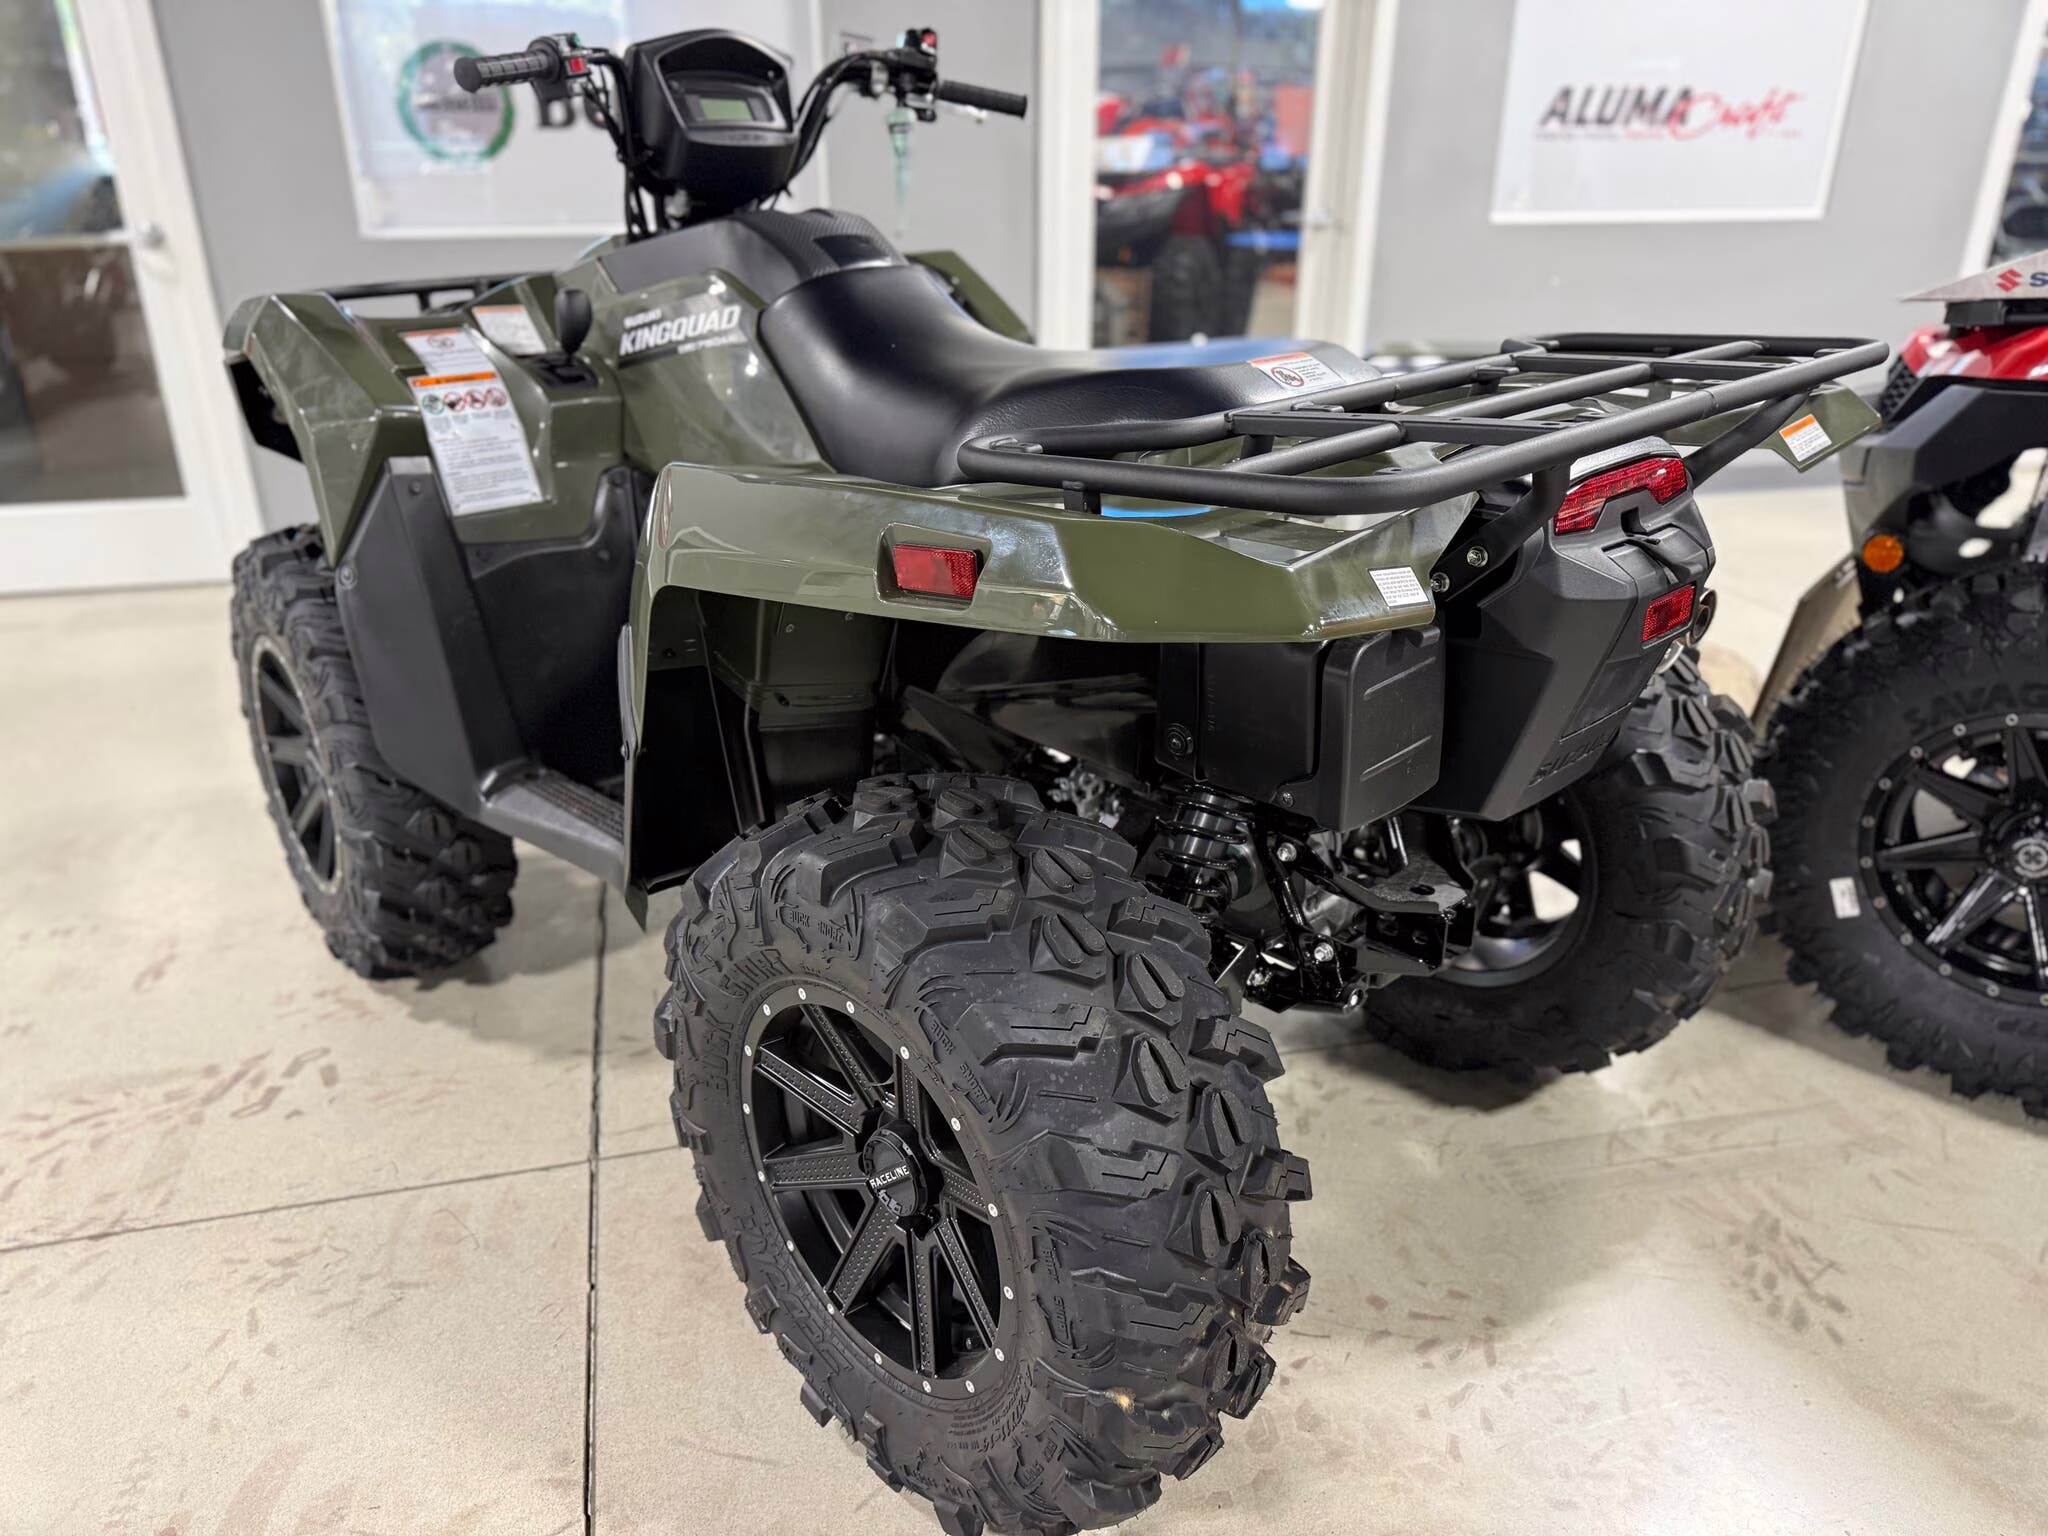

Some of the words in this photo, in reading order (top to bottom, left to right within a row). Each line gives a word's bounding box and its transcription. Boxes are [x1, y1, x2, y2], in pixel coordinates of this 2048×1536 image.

[619, 305, 742, 357] KINGQUAD
[959, 1061, 993, 1106] SNORT
[868, 1164, 911, 1190] RACELINE
